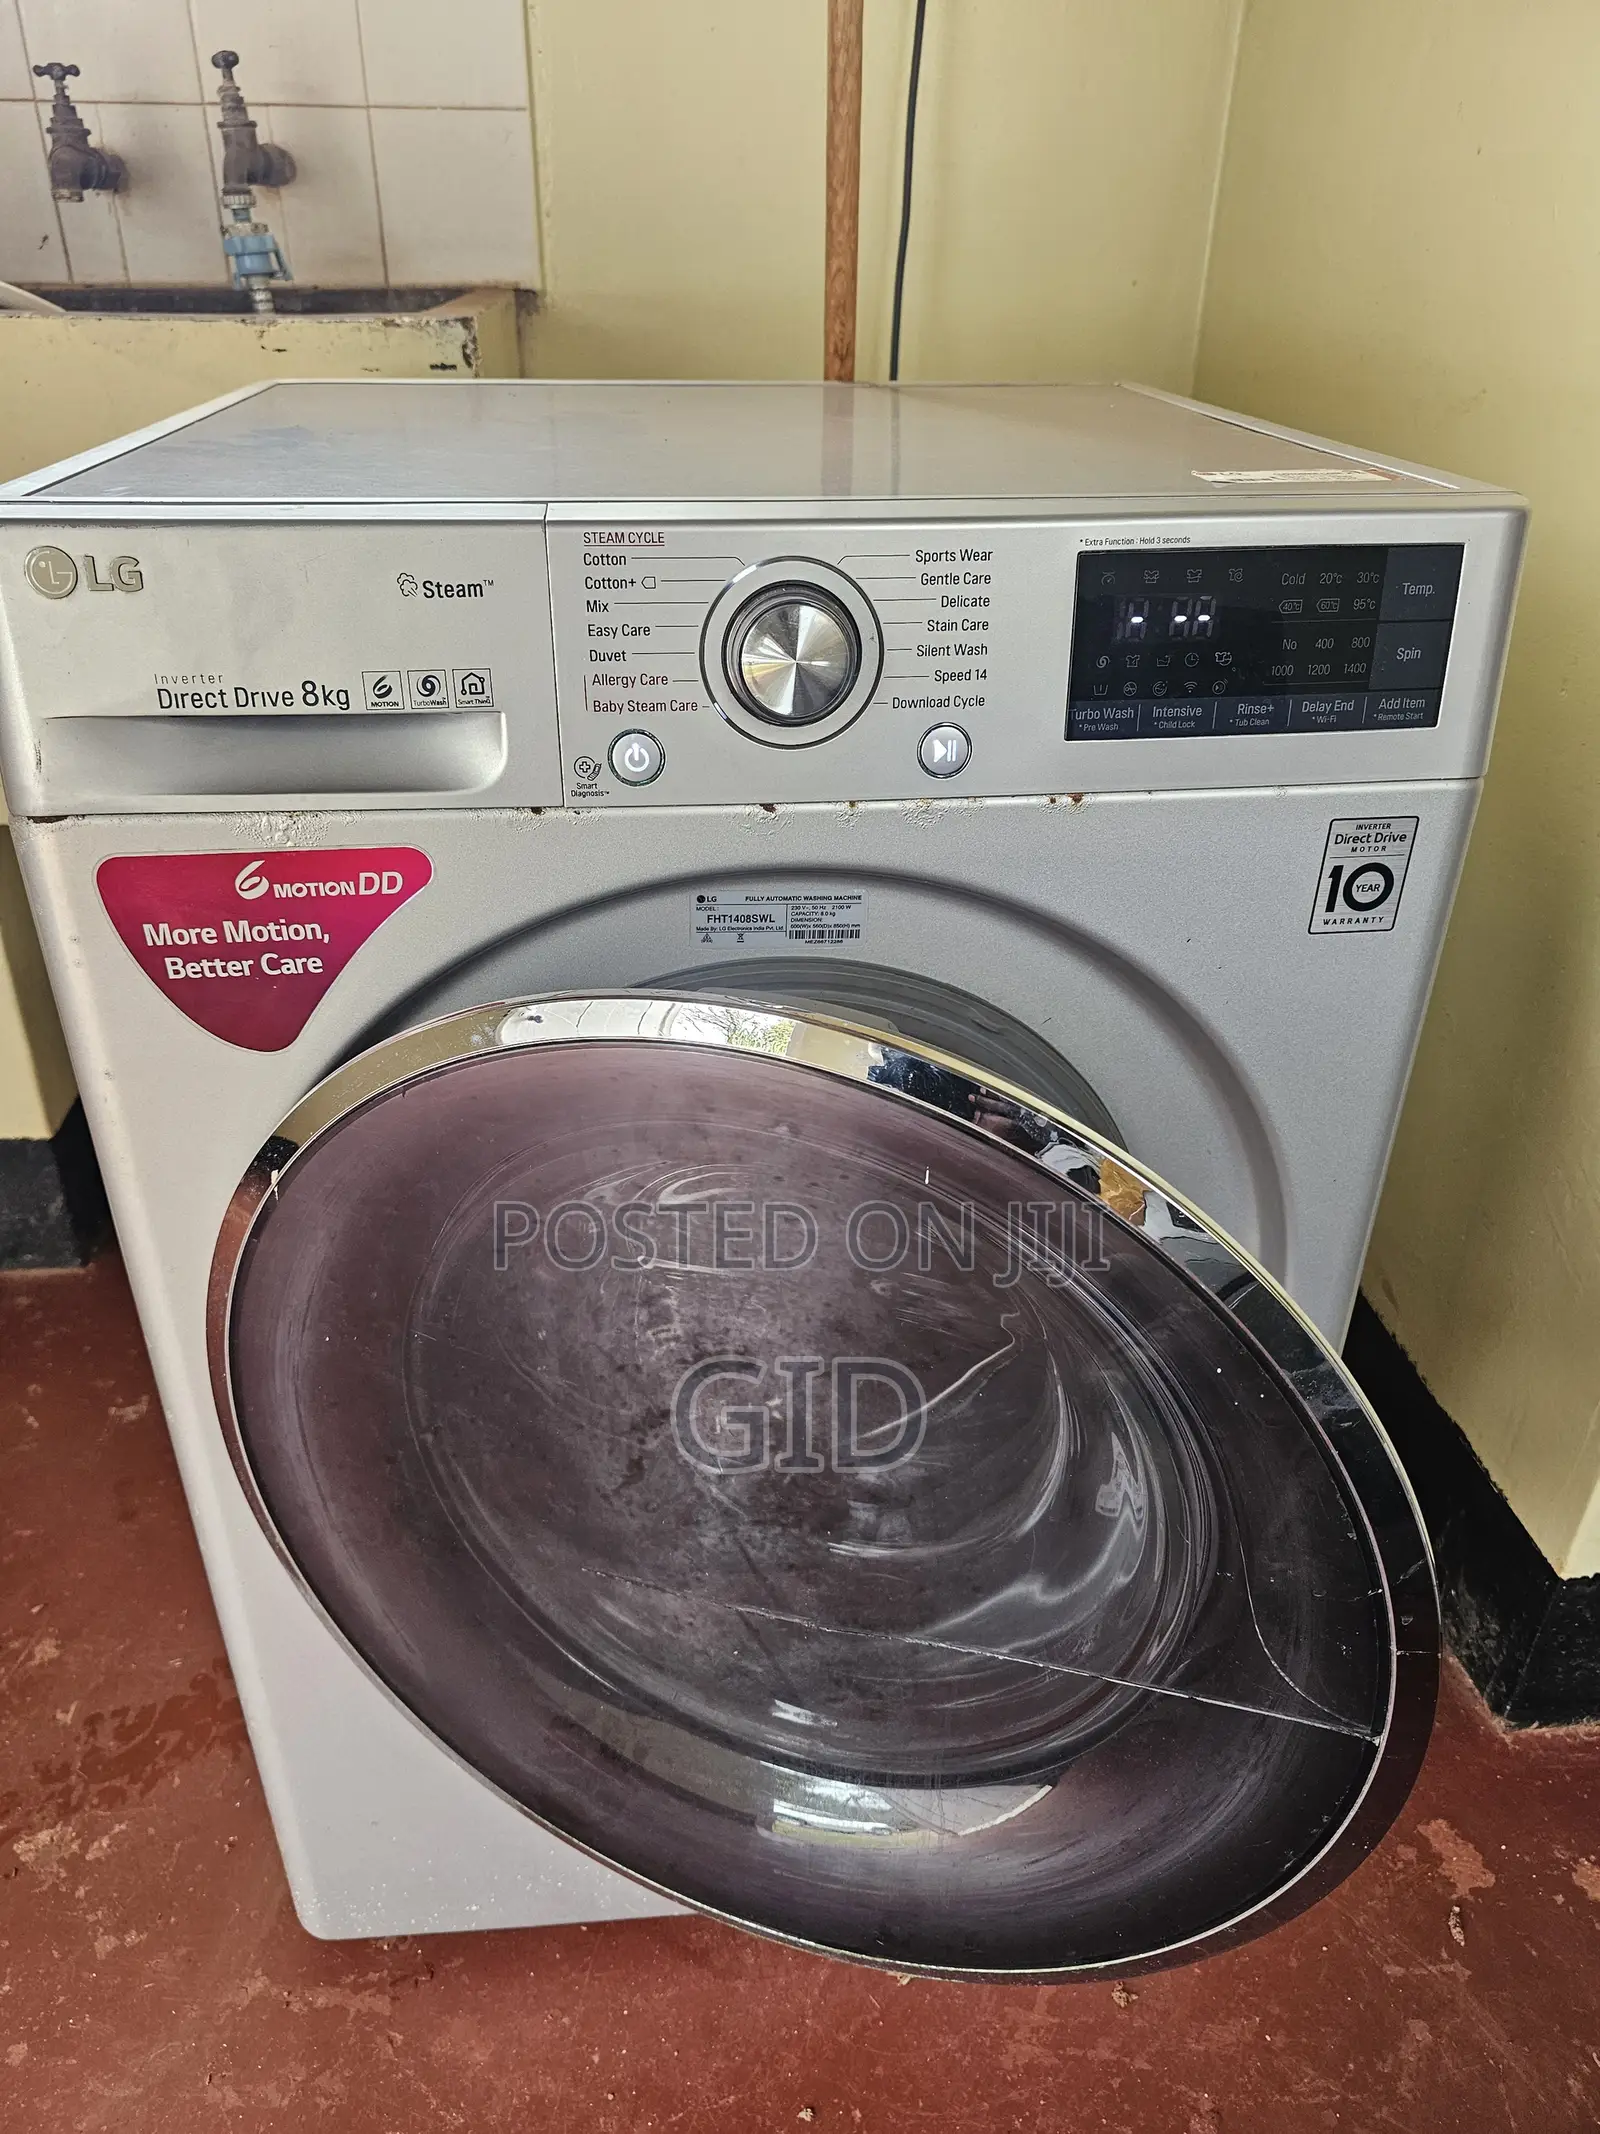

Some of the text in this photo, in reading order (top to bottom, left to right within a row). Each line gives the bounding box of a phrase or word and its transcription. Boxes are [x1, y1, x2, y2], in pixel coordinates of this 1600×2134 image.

[583, 531, 665, 544] STEAM CYCLE
[1084, 538, 1103, 546] Extra
[1104, 537, 1135, 546] Function
[1139, 536, 1155, 545] Hold
[1156, 536, 1161, 544] 3
[1161, 535, 1191, 544] seconds
[583, 552, 627, 566] Cotton
[915, 548, 994, 565] Sports Wear
[84, 554, 144, 592] LG
[920, 571, 991, 586] Gentle Care
[1281, 573, 1306, 586] Cold
[584, 576, 636, 589] Cotton+
[1402, 582, 1436, 597] Temp.
[586, 599, 610, 613] Mix
[941, 595, 990, 608] Delicate
[588, 623, 651, 640] Easy Care
[927, 618, 989, 632] Stain Care
[1282, 639, 1297, 650] No
[1315, 637, 1335, 649] 400
[1351, 636, 1371, 648] 800
[589, 649, 627, 662] Duvet
[916, 643, 988, 657] Silent Wash
[1396, 647, 1421, 662] Spin
[1271, 664, 1294, 677] 1000
[1307, 663, 1331, 676] 1200
[1343, 662, 1367, 674] 1400
[153, 673, 224, 685] Inverter
[592, 673, 668, 688] Allergy Care
[934, 668, 988, 684] Speed 14
[157, 687, 229, 709] Direct
[233, 686, 295, 708] Drive
[892, 694, 986, 710] Download Cycle
[1378, 697, 1426, 710] Add Item
[593, 699, 698, 715] Baby Steam Care
[1103, 706, 1135, 719] Wash
[1152, 704, 1203, 718] Intensive
[1237, 702, 1275, 715] Rinse+
[1301, 699, 1355, 714] Delay End
[1235, 717, 1270, 727] Tub Clean
[1316, 714, 1337, 723] Wi-Fi
[1377, 712, 1424, 721] Remote Start
[1083, 722, 1119, 731] Pre Wash
[1158, 720, 1196, 729] Child Lock
[576, 782, 598, 790] Smart
[1355, 822, 1391, 830] INVERTER
[1334, 831, 1407, 845] Direct Drive
[1350, 845, 1387, 853] MOTOR
[272, 880, 356, 899] MOTION
[1324, 862, 1395, 913] 10
[1355, 883, 1381, 892] YEAR
[707, 914, 776, 924] FHT1408SWL
[1323, 916, 1385, 926] WARRANTY
[142, 918, 330, 947] More Motion,
[164, 952, 324, 980] Better Care
